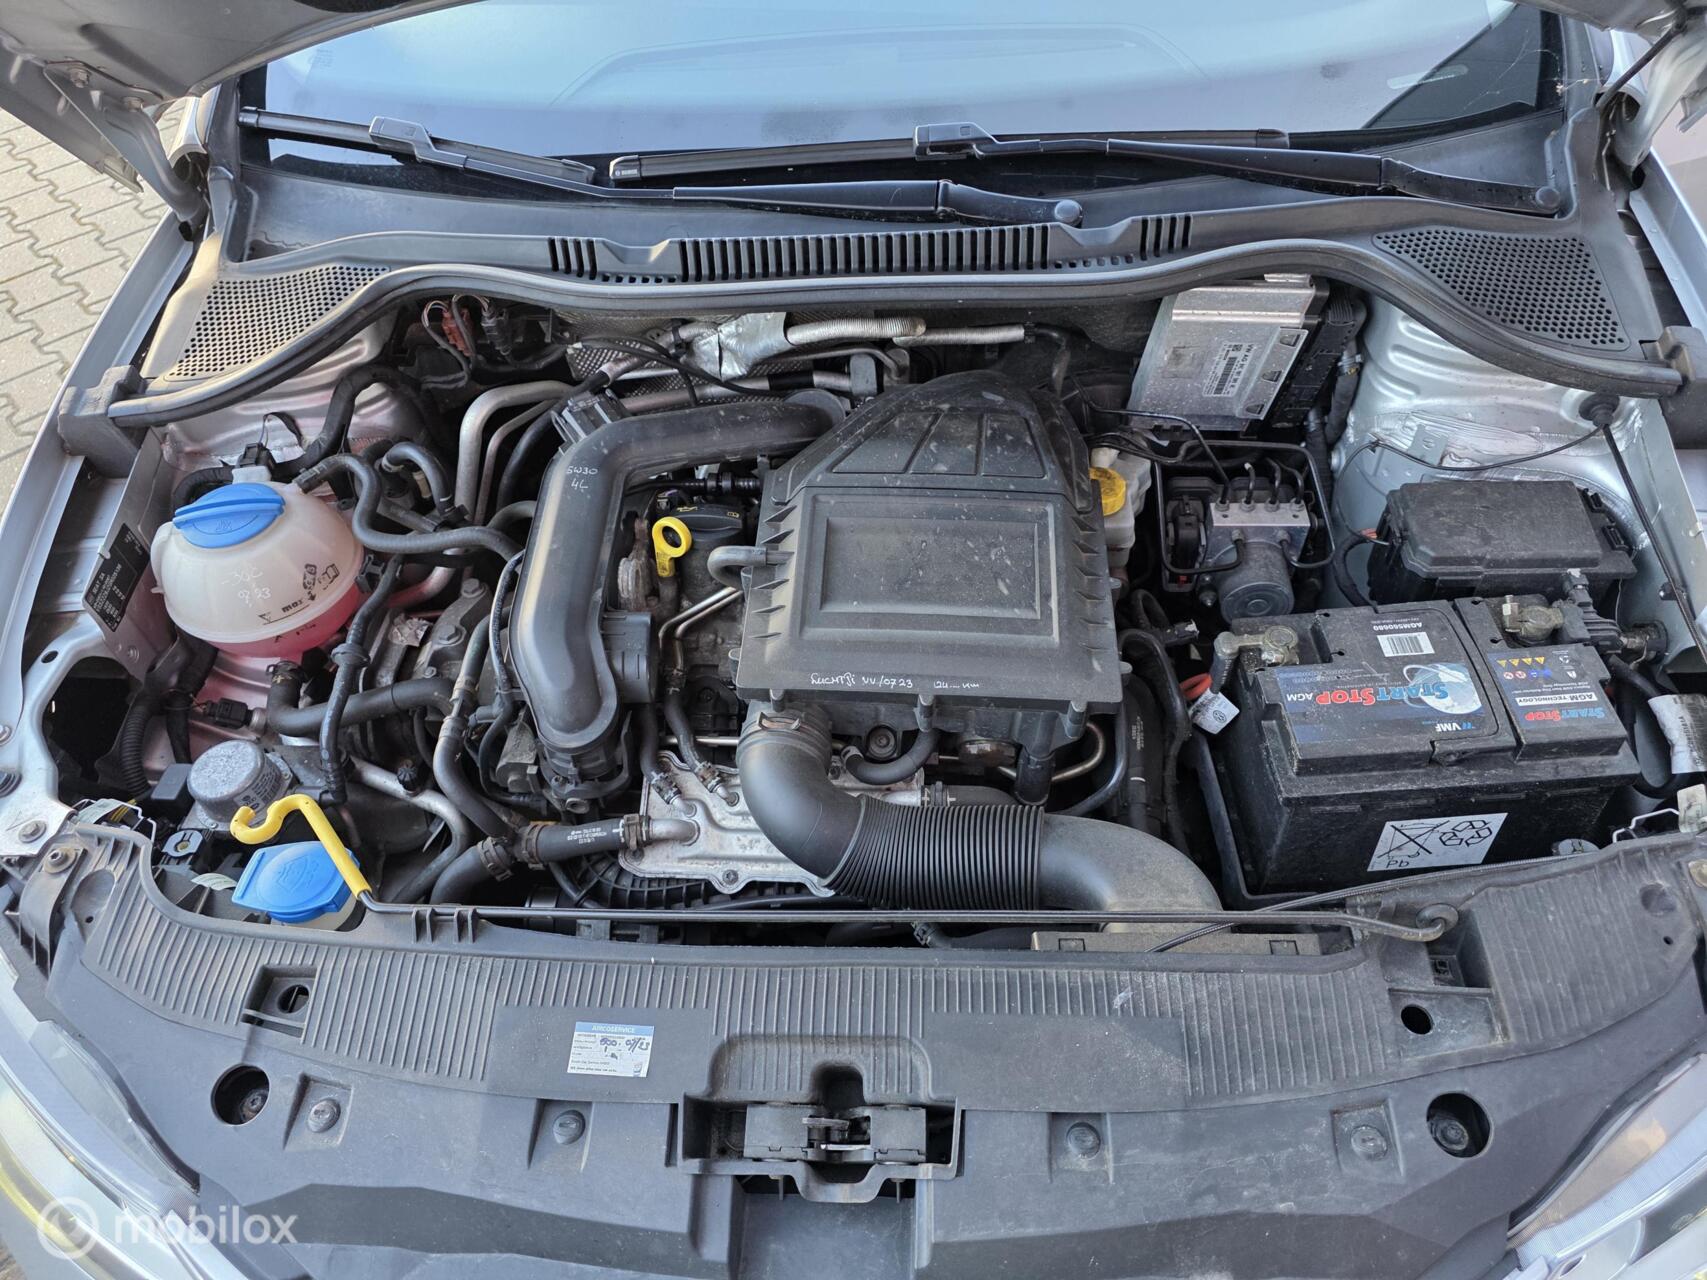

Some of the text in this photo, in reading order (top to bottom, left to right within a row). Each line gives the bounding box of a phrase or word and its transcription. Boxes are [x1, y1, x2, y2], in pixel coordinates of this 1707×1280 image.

[1286, 692, 1314, 702] AGM
[1518, 692, 1593, 703] AGM TECHNOLOGY
[1434, 722, 1462, 732] VMF
[1386, 860, 1410, 868] Pb
